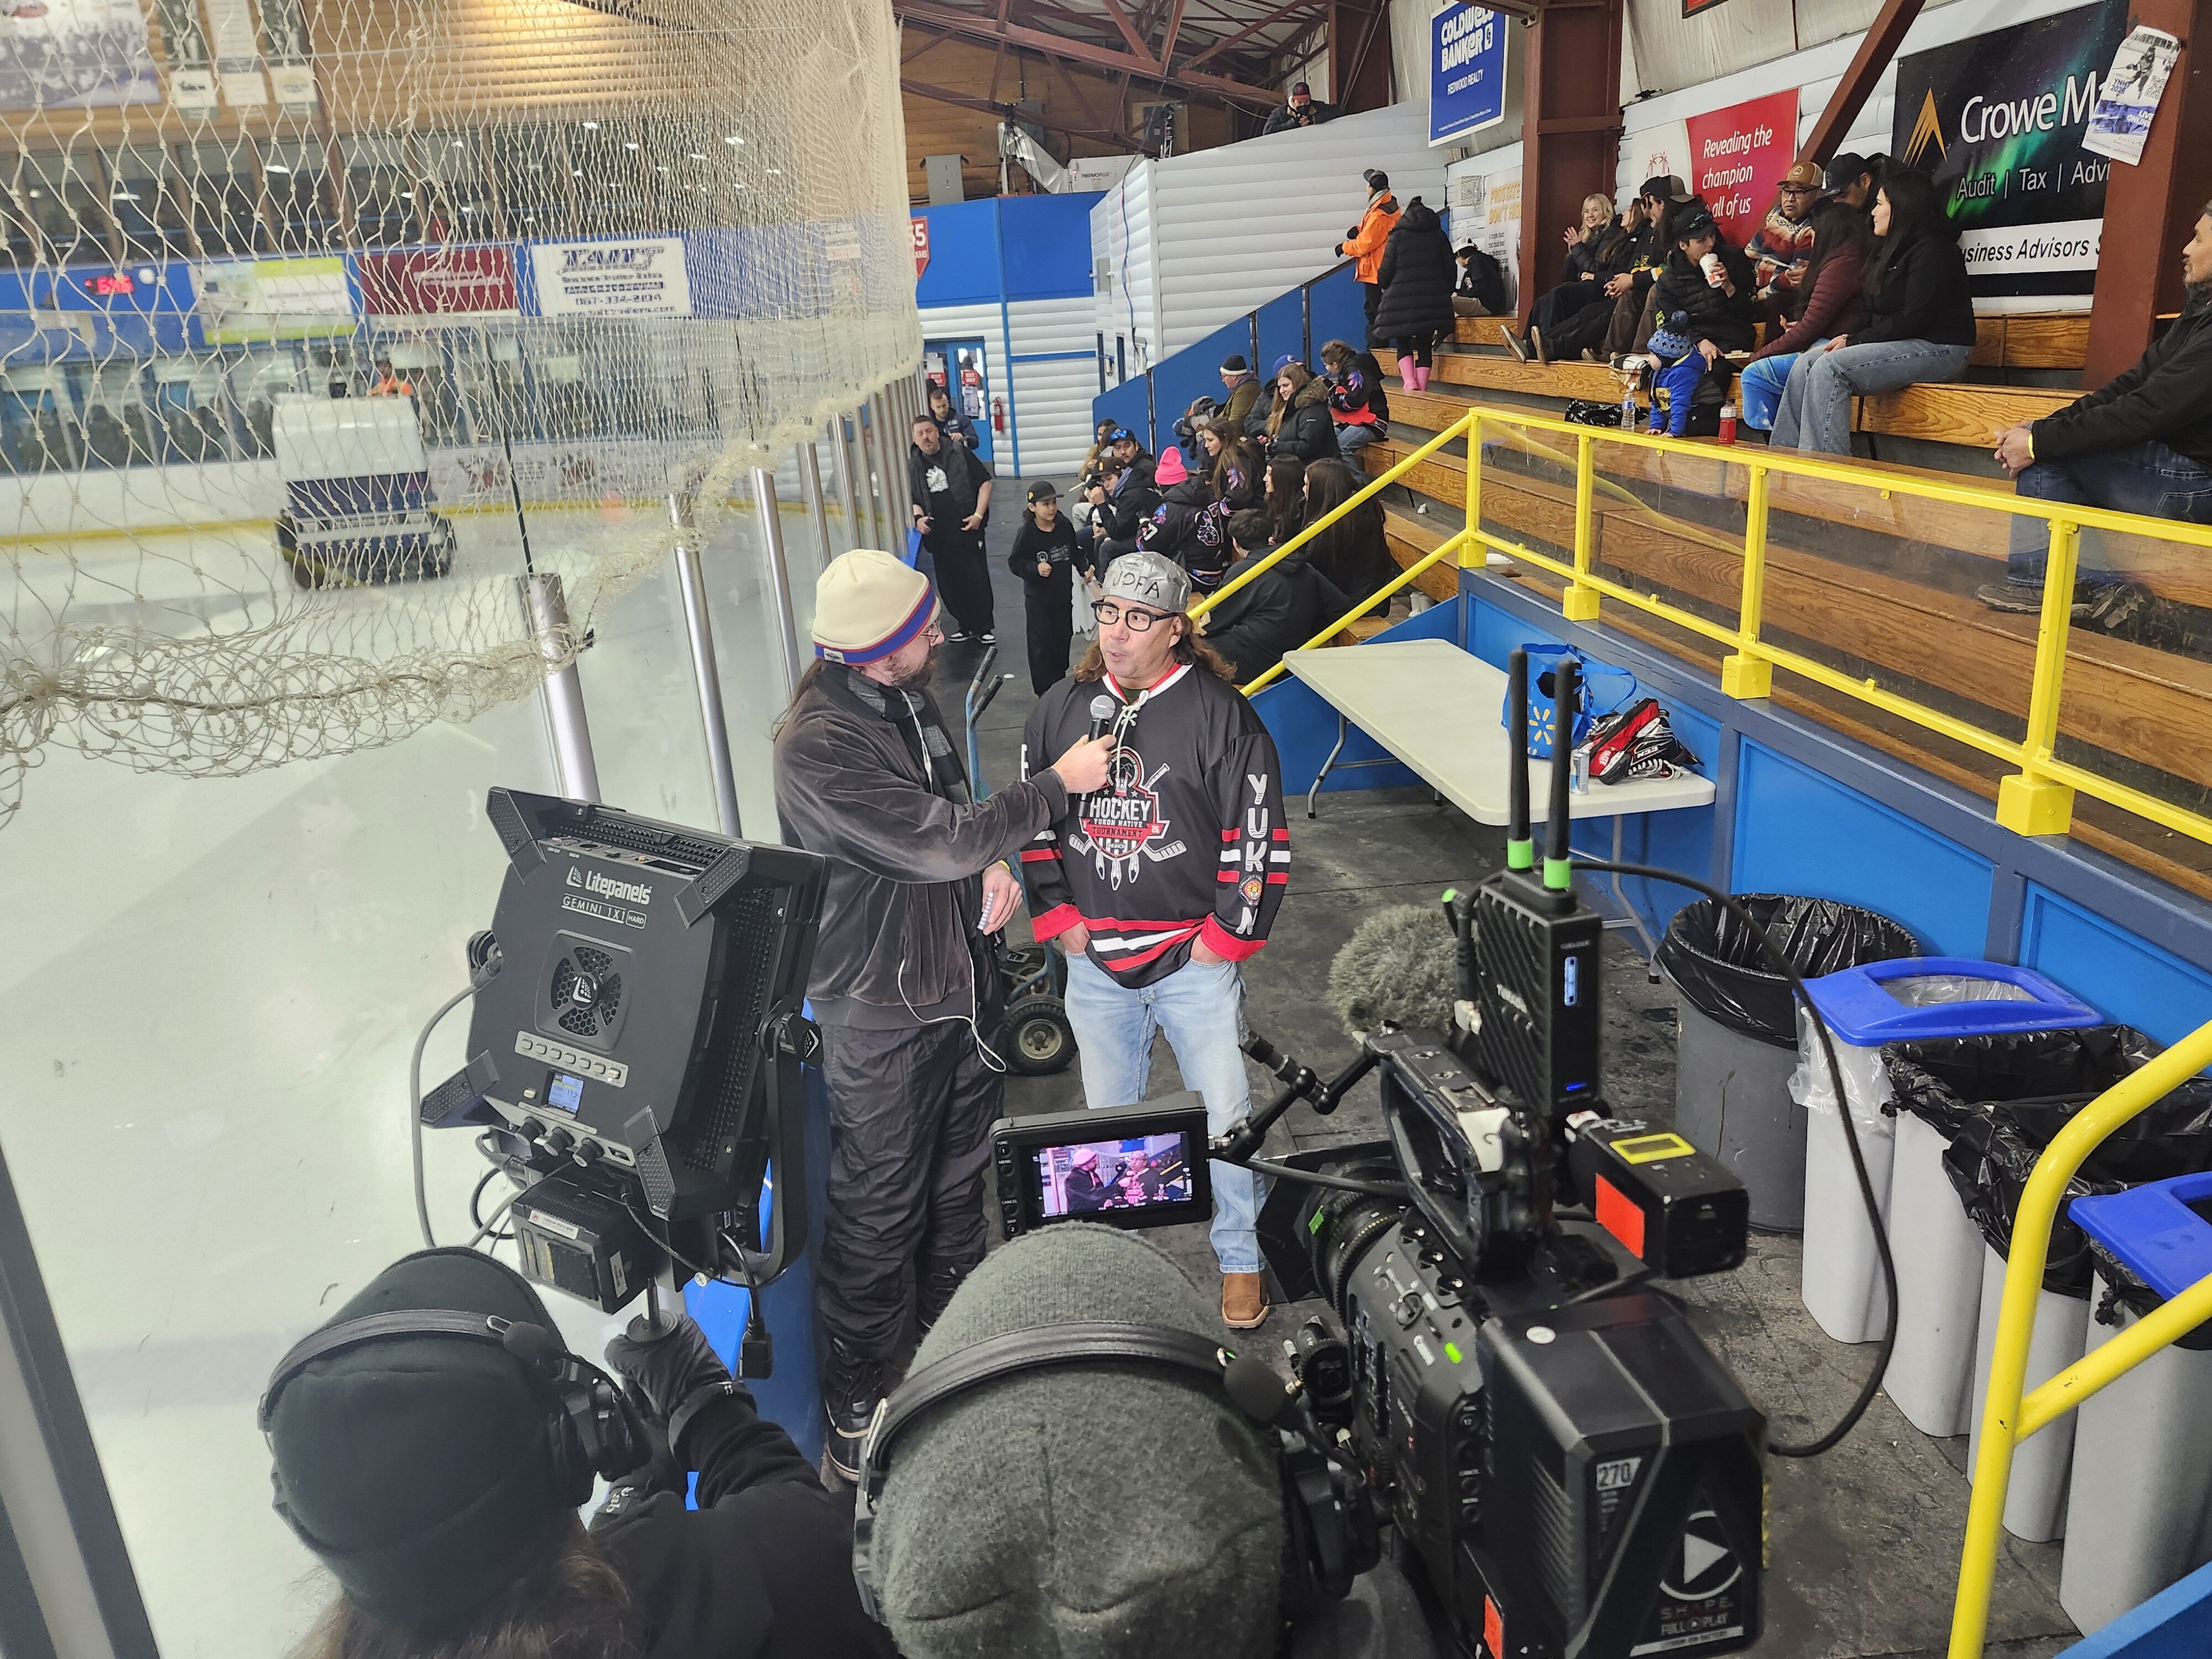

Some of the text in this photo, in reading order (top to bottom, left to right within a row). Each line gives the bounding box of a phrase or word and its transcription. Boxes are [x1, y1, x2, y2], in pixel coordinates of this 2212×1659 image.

[1447, 69, 1484, 96] REDWOOD REALTY
[1961, 71, 2106, 144] Crowe M
[2138, 110, 2154, 120] LIVE
[2126, 114, 2152, 127] ONLINE
[1703, 124, 1773, 159] Revealing the
[1702, 162, 1753, 190] champion
[1957, 174, 1995, 199] Audit
[2019, 168, 2047, 191] Tax
[1490, 181, 1521, 204] PROSTATE
[1489, 204, 1507, 224] DON'T
[1712, 193, 1752, 220] all of us
[2016, 237, 2090, 260] Advisors
[1089, 797, 1151, 821] HOCKEY
[1092, 827, 1142, 837] TOURNAMENT
[1094, 818, 1116, 827] YUKON
[1118, 820, 1143, 828] NATIVE
[585, 870, 651, 905] Litepanels
[562, 895, 644, 925] GEMINI 1X1 HARD
[1599, 1462, 1631, 1487] 270
[1661, 1596, 1731, 1619] SHAPE
